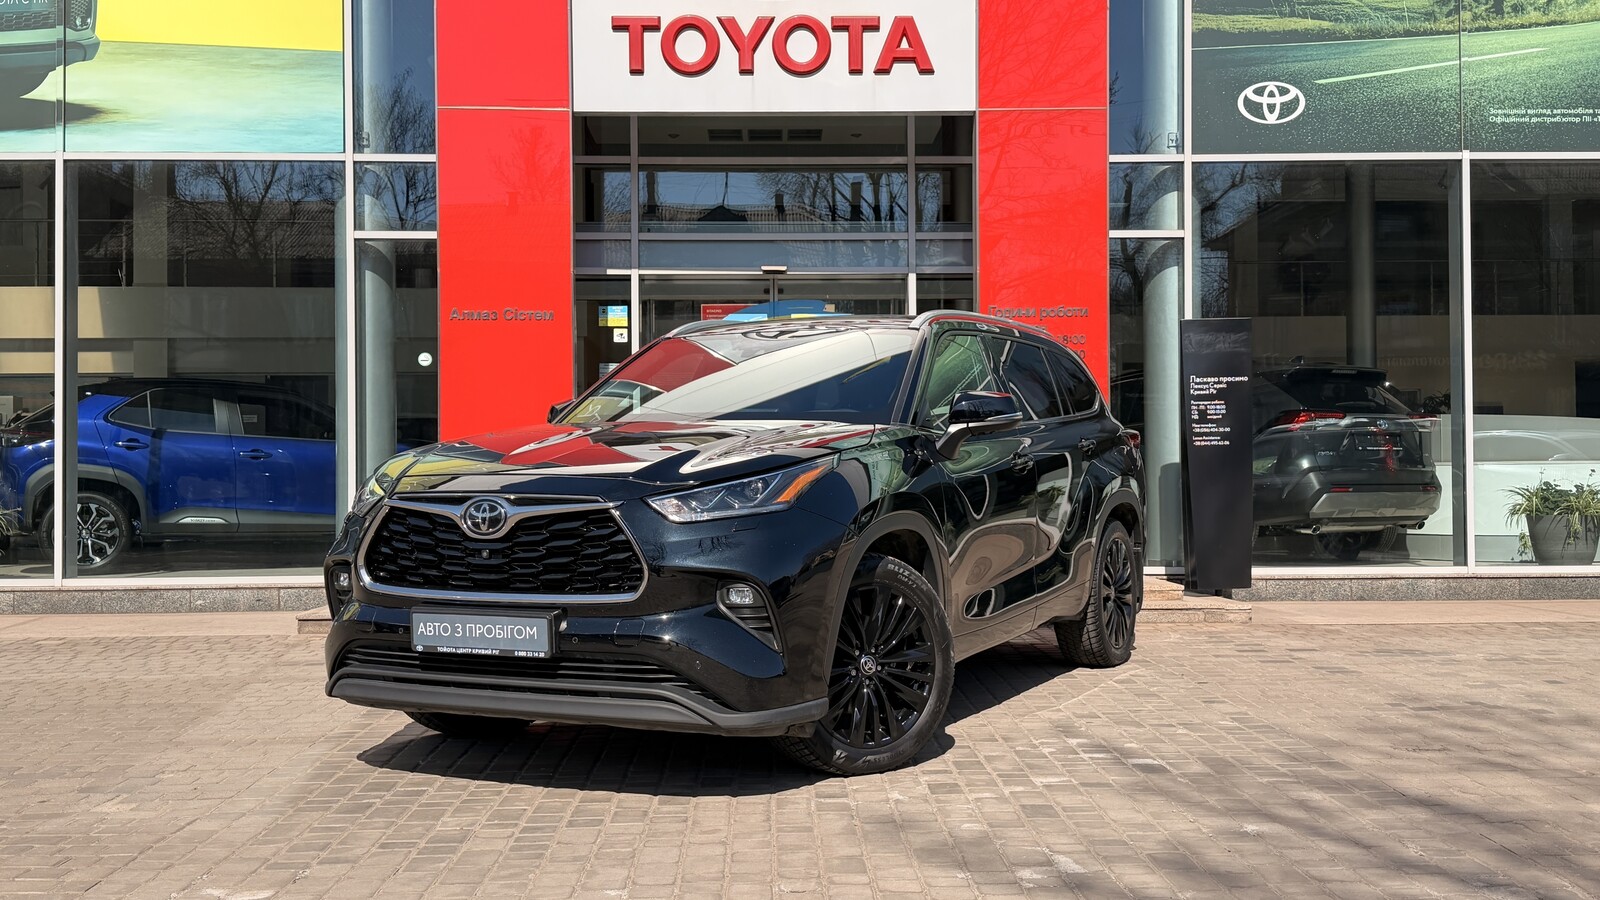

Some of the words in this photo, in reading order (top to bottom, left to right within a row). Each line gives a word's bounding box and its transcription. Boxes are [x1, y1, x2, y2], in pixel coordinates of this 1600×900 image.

[611, 14, 935, 76] TOYOTA
[1489, 107, 1526, 115] Зовнішній
[450, 307, 498, 321] Алмаз
[503, 308, 555, 321] Сістем
[988, 306, 1036, 319] Години
[1040, 304, 1089, 321] роботи
[417, 622, 451, 636] АВТО
[466, 624, 537, 639] ПРОБІГОМ
